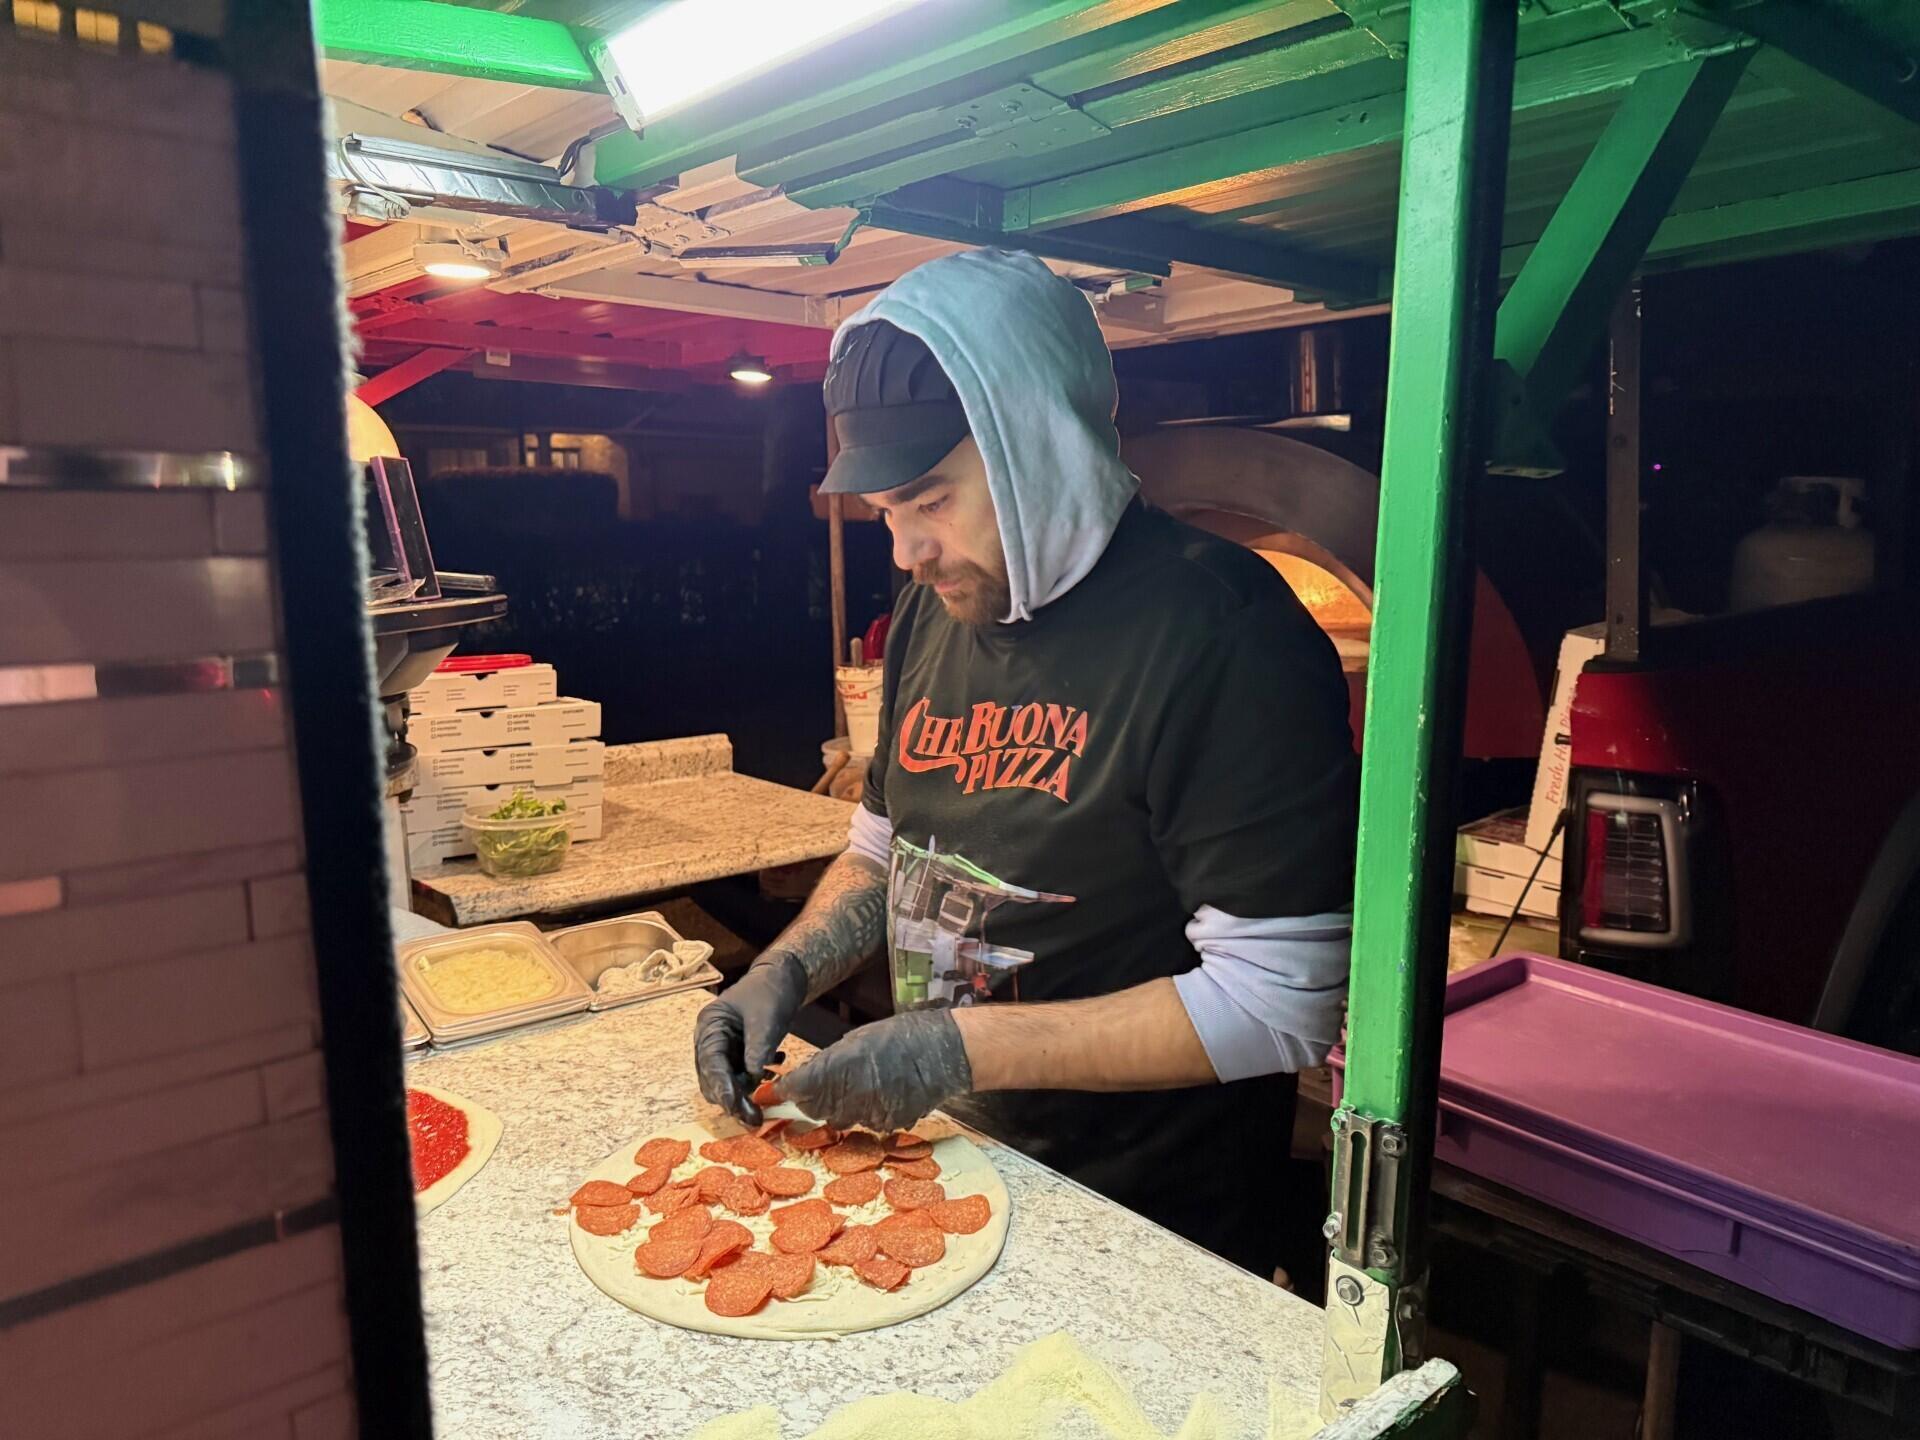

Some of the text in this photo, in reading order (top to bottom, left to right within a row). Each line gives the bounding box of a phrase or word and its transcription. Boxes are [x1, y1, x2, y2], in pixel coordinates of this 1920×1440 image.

[960, 701, 1088, 758] BUONA
[962, 747, 1071, 804] PIZZA
[1545, 763, 1565, 804] Fresh
